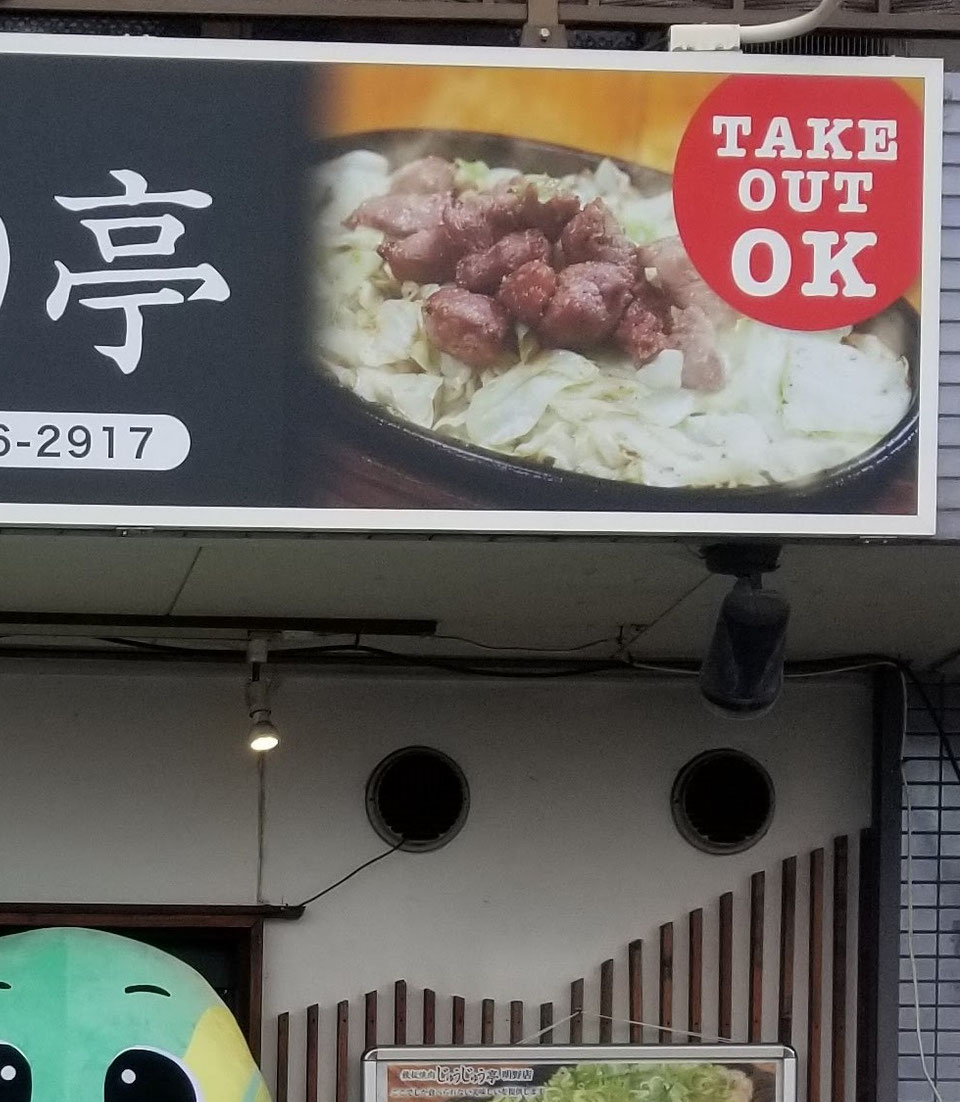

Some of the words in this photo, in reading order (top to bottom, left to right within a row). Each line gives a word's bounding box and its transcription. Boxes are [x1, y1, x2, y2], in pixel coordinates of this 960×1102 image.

[712, 114, 898, 161] TAKE
[738, 168, 874, 213] OUT
[731, 228, 878, 298] OK
